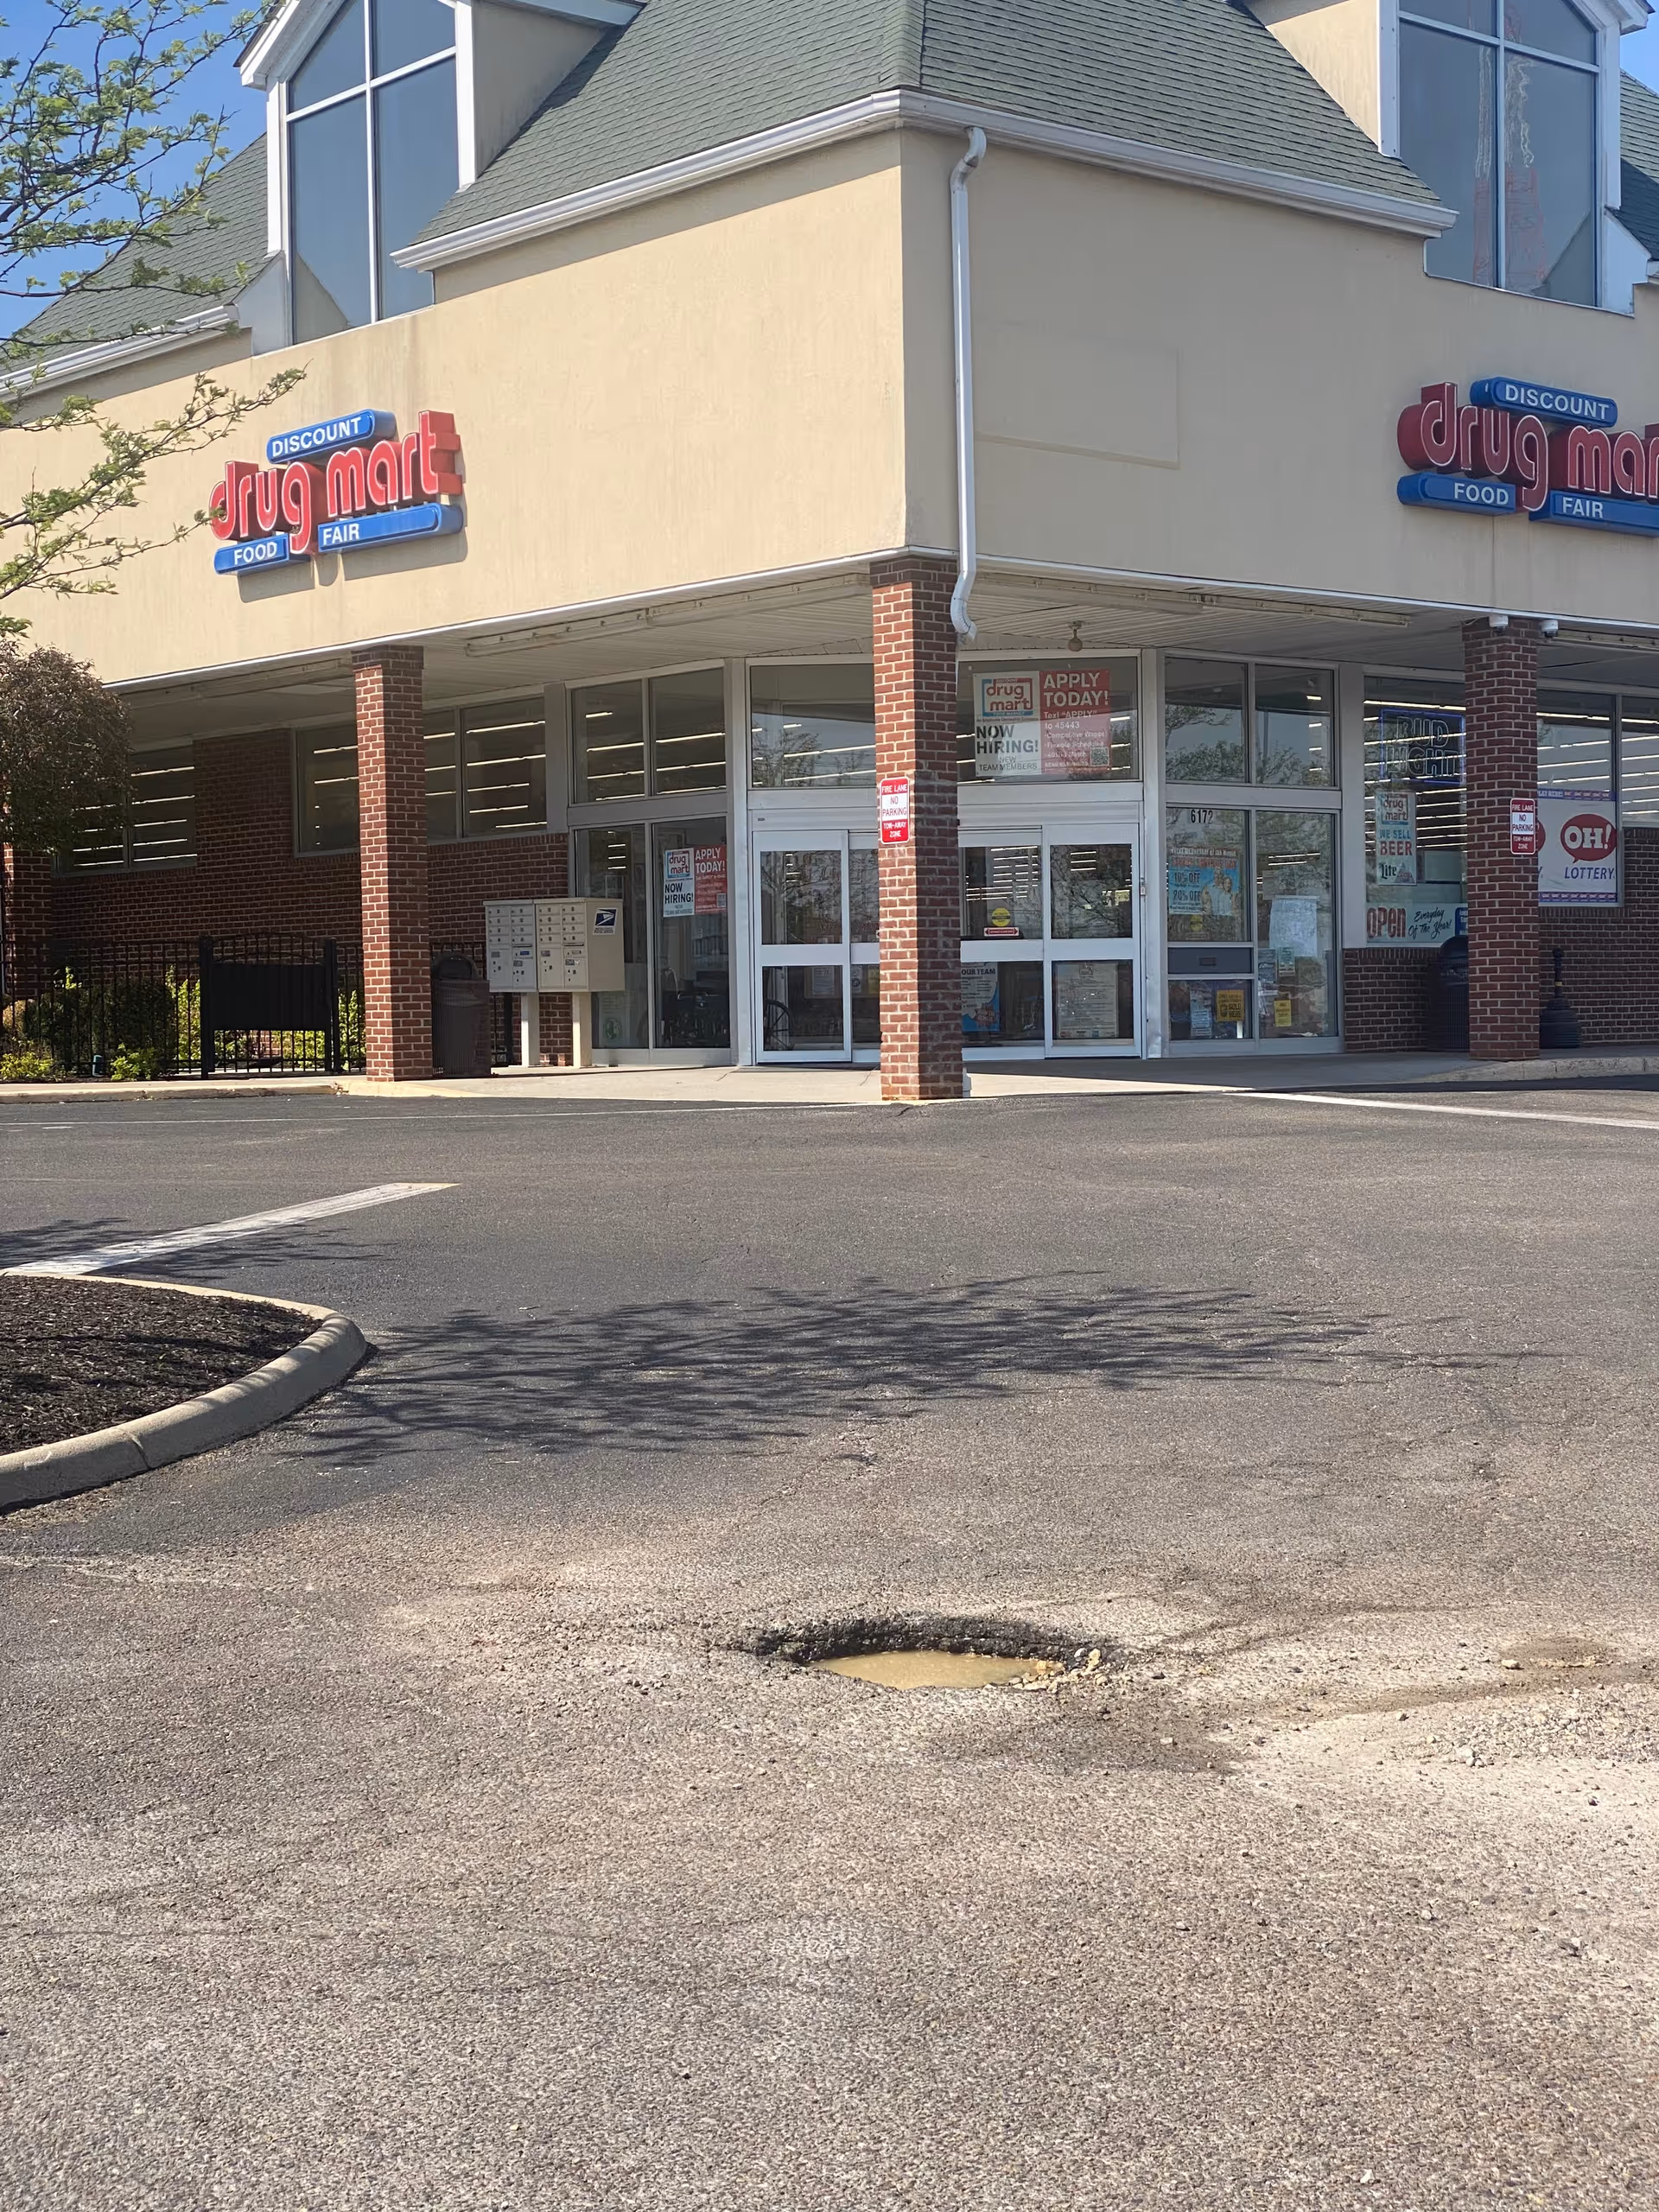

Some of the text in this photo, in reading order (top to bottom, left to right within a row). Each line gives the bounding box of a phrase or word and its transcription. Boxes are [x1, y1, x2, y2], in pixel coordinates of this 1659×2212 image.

[1504, 383, 1610, 421] DISCOUNT
[270, 416, 362, 459] DISCOUNT
[1421, 381, 1659, 512] drug mar
[209, 410, 442, 555] drug mart
[1454, 482, 1510, 506] FOOD
[1561, 496, 1605, 519] FAIR
[322, 522, 360, 546] FAIR
[233, 541, 278, 566] FOOD
[1043, 671, 1100, 690] APPLY
[986, 678, 1025, 700] drug
[989, 697, 1033, 712] mart
[1044, 690, 1109, 707] TODAY!
[976, 724, 1014, 739] NOW
[1396, 715, 1449, 748] BUD
[976, 739, 1039, 754] HIRING!
[979, 763, 1001, 772] TEAM
[1001, 762, 1038, 771] MEMBERS
[999, 755, 1017, 764] NEW
[881, 784, 908, 793] FIRE LANE
[890, 796, 899, 804] NO
[1383, 794, 1404, 812] drug
[882, 807, 907, 817] PARKING
[1191, 809, 1214, 823] 6172
[1385, 811, 1408, 821] mart
[1379, 829, 1411, 839] WE SELL
[1512, 823, 1534, 832] PARKING
[1564, 823, 1612, 850] OH!
[695, 847, 721, 861] APPLY
[1380, 840, 1413, 855] BEER
[669, 852, 686, 866] drug
[671, 865, 690, 874] mart
[695, 861, 726, 874] TODAY!
[1377, 861, 1397, 880] Lite
[1189, 872, 1201, 884] OFF
[664, 881, 683, 893] NOW
[664, 893, 694, 905] HIRING!
[1189, 890, 1201, 901] OFF
[1414, 906, 1445, 923] Everyday
[1408, 925, 1419, 940] Of
[1420, 923, 1430, 933] The
[1431, 918, 1452, 940] Year!
